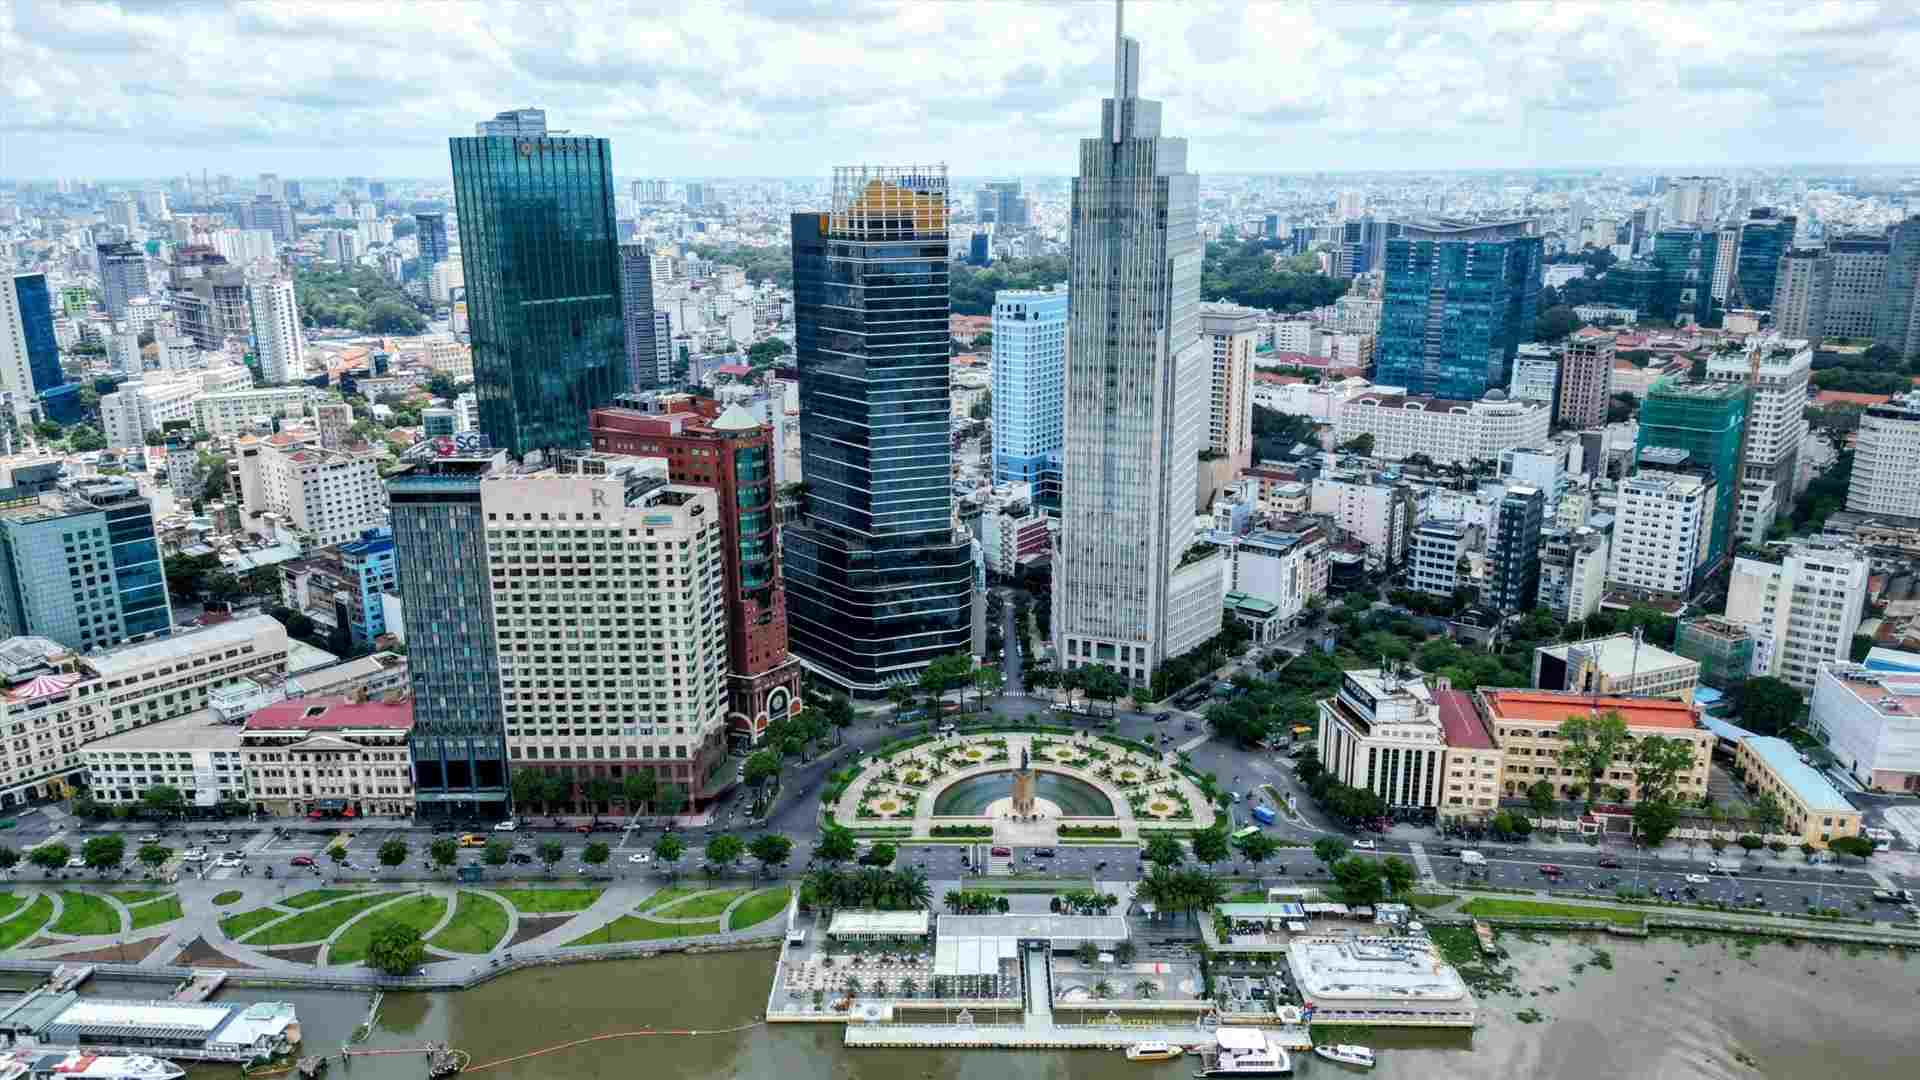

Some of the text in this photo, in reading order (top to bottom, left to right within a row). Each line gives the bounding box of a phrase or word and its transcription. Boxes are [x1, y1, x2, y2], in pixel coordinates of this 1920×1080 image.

[902, 175, 945, 188] Hilton
[456, 435, 490, 449] SC
[591, 488, 609, 506] R
